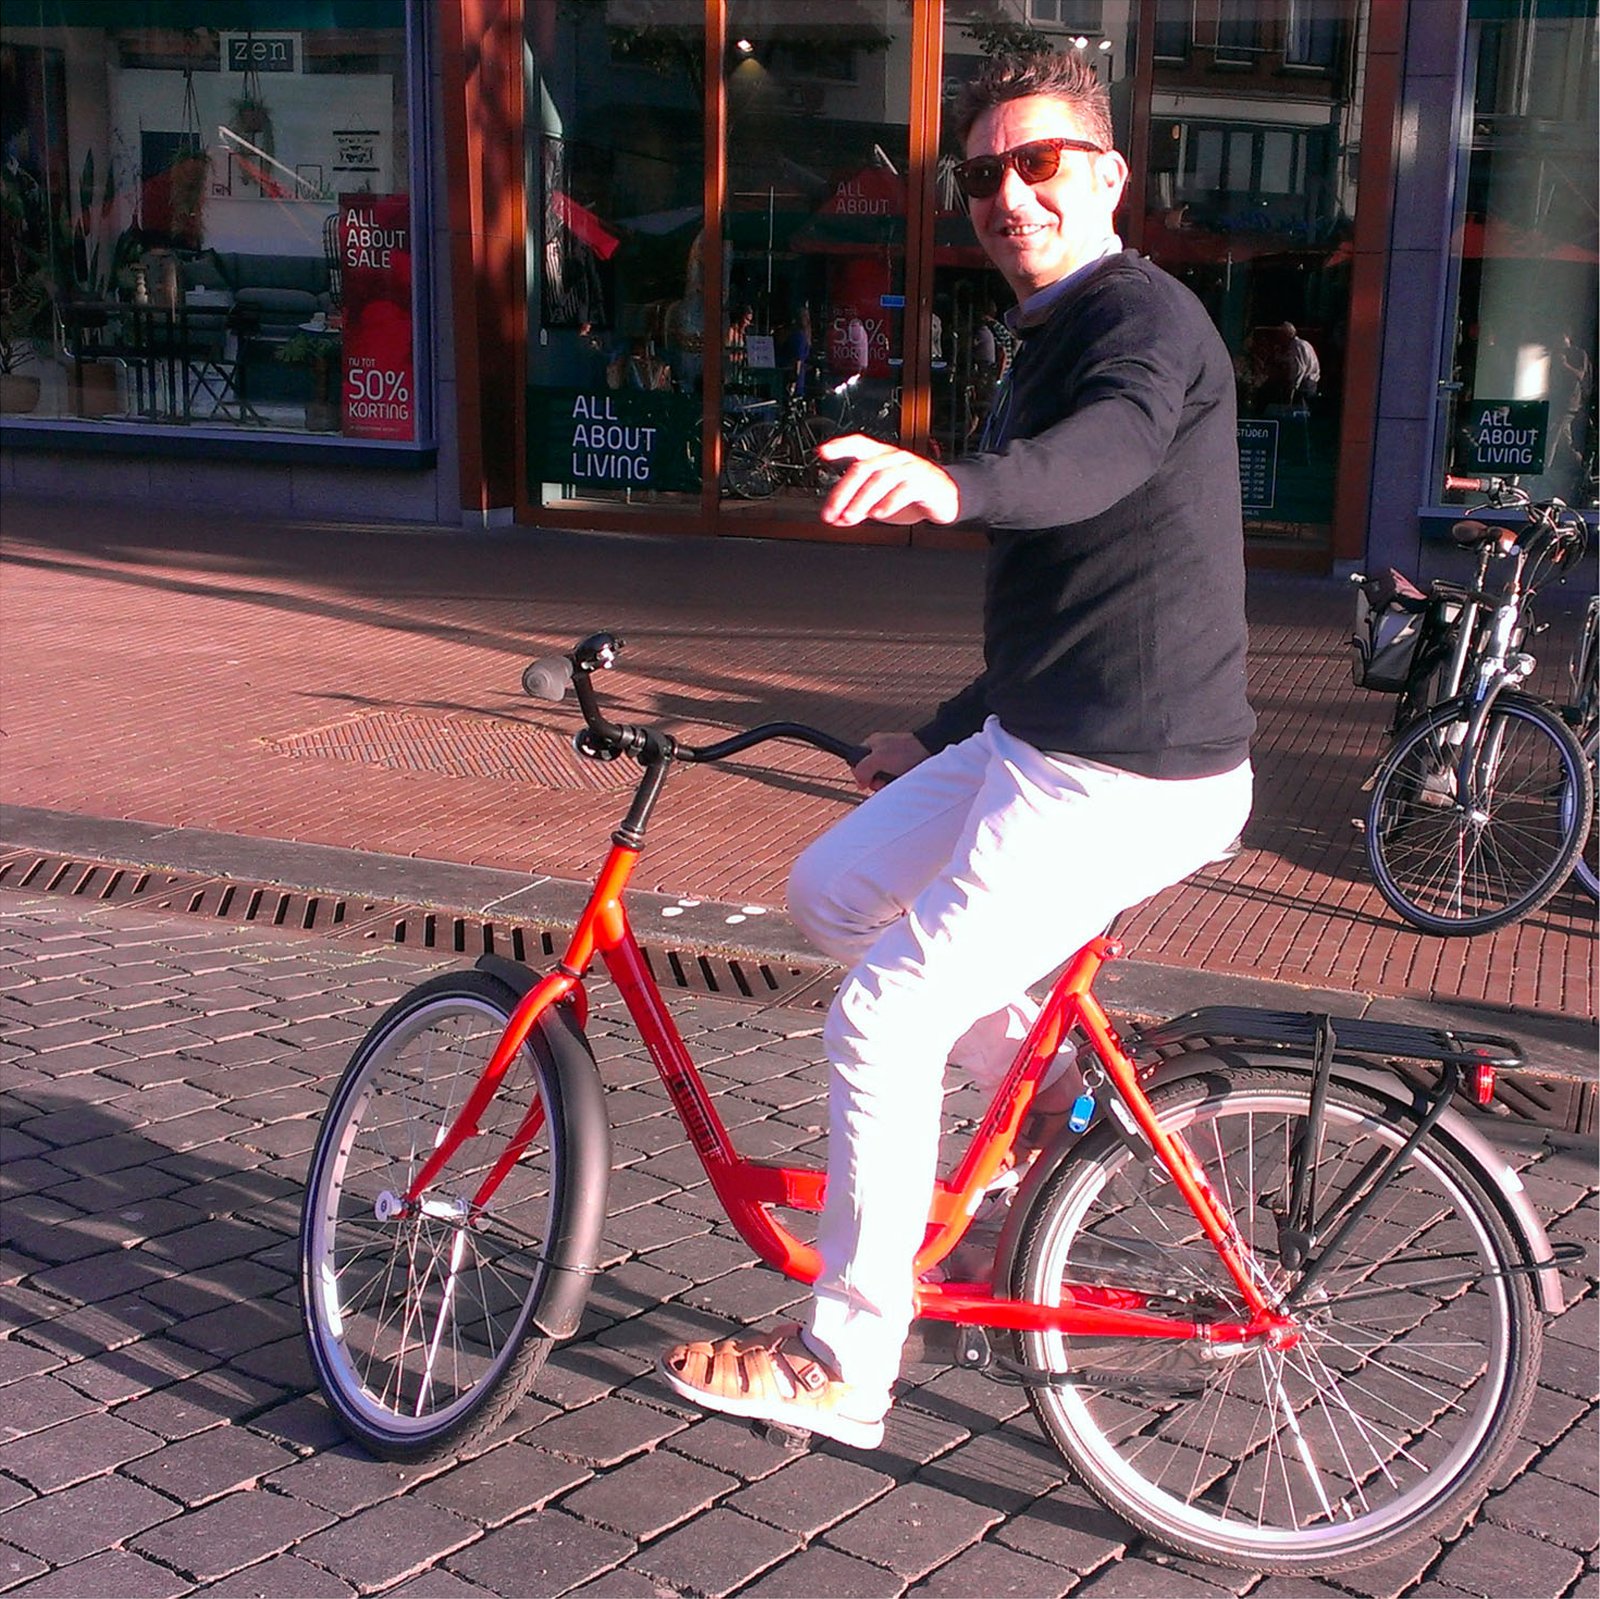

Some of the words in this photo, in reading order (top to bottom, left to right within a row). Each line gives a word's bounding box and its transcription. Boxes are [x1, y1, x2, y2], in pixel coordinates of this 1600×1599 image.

[235, 41, 287, 61] zen
[836, 181, 865, 197] ALL
[836, 198, 889, 215] ABOUT
[346, 208, 379, 228] ALL
[346, 228, 406, 249] ABOUT
[347, 249, 391, 269] SALE
[361, 358, 376, 368] TOT
[349, 368, 409, 403] 50%
[349, 402, 409, 420] KORTING
[572, 395, 618, 420] ALL
[1479, 409, 1512, 427] ALL
[572, 424, 656, 452] ABOUT
[1478, 427, 1539, 446] ABOUT
[1477, 447, 1533, 464] LIVING
[572, 452, 650, 480] LIVING
